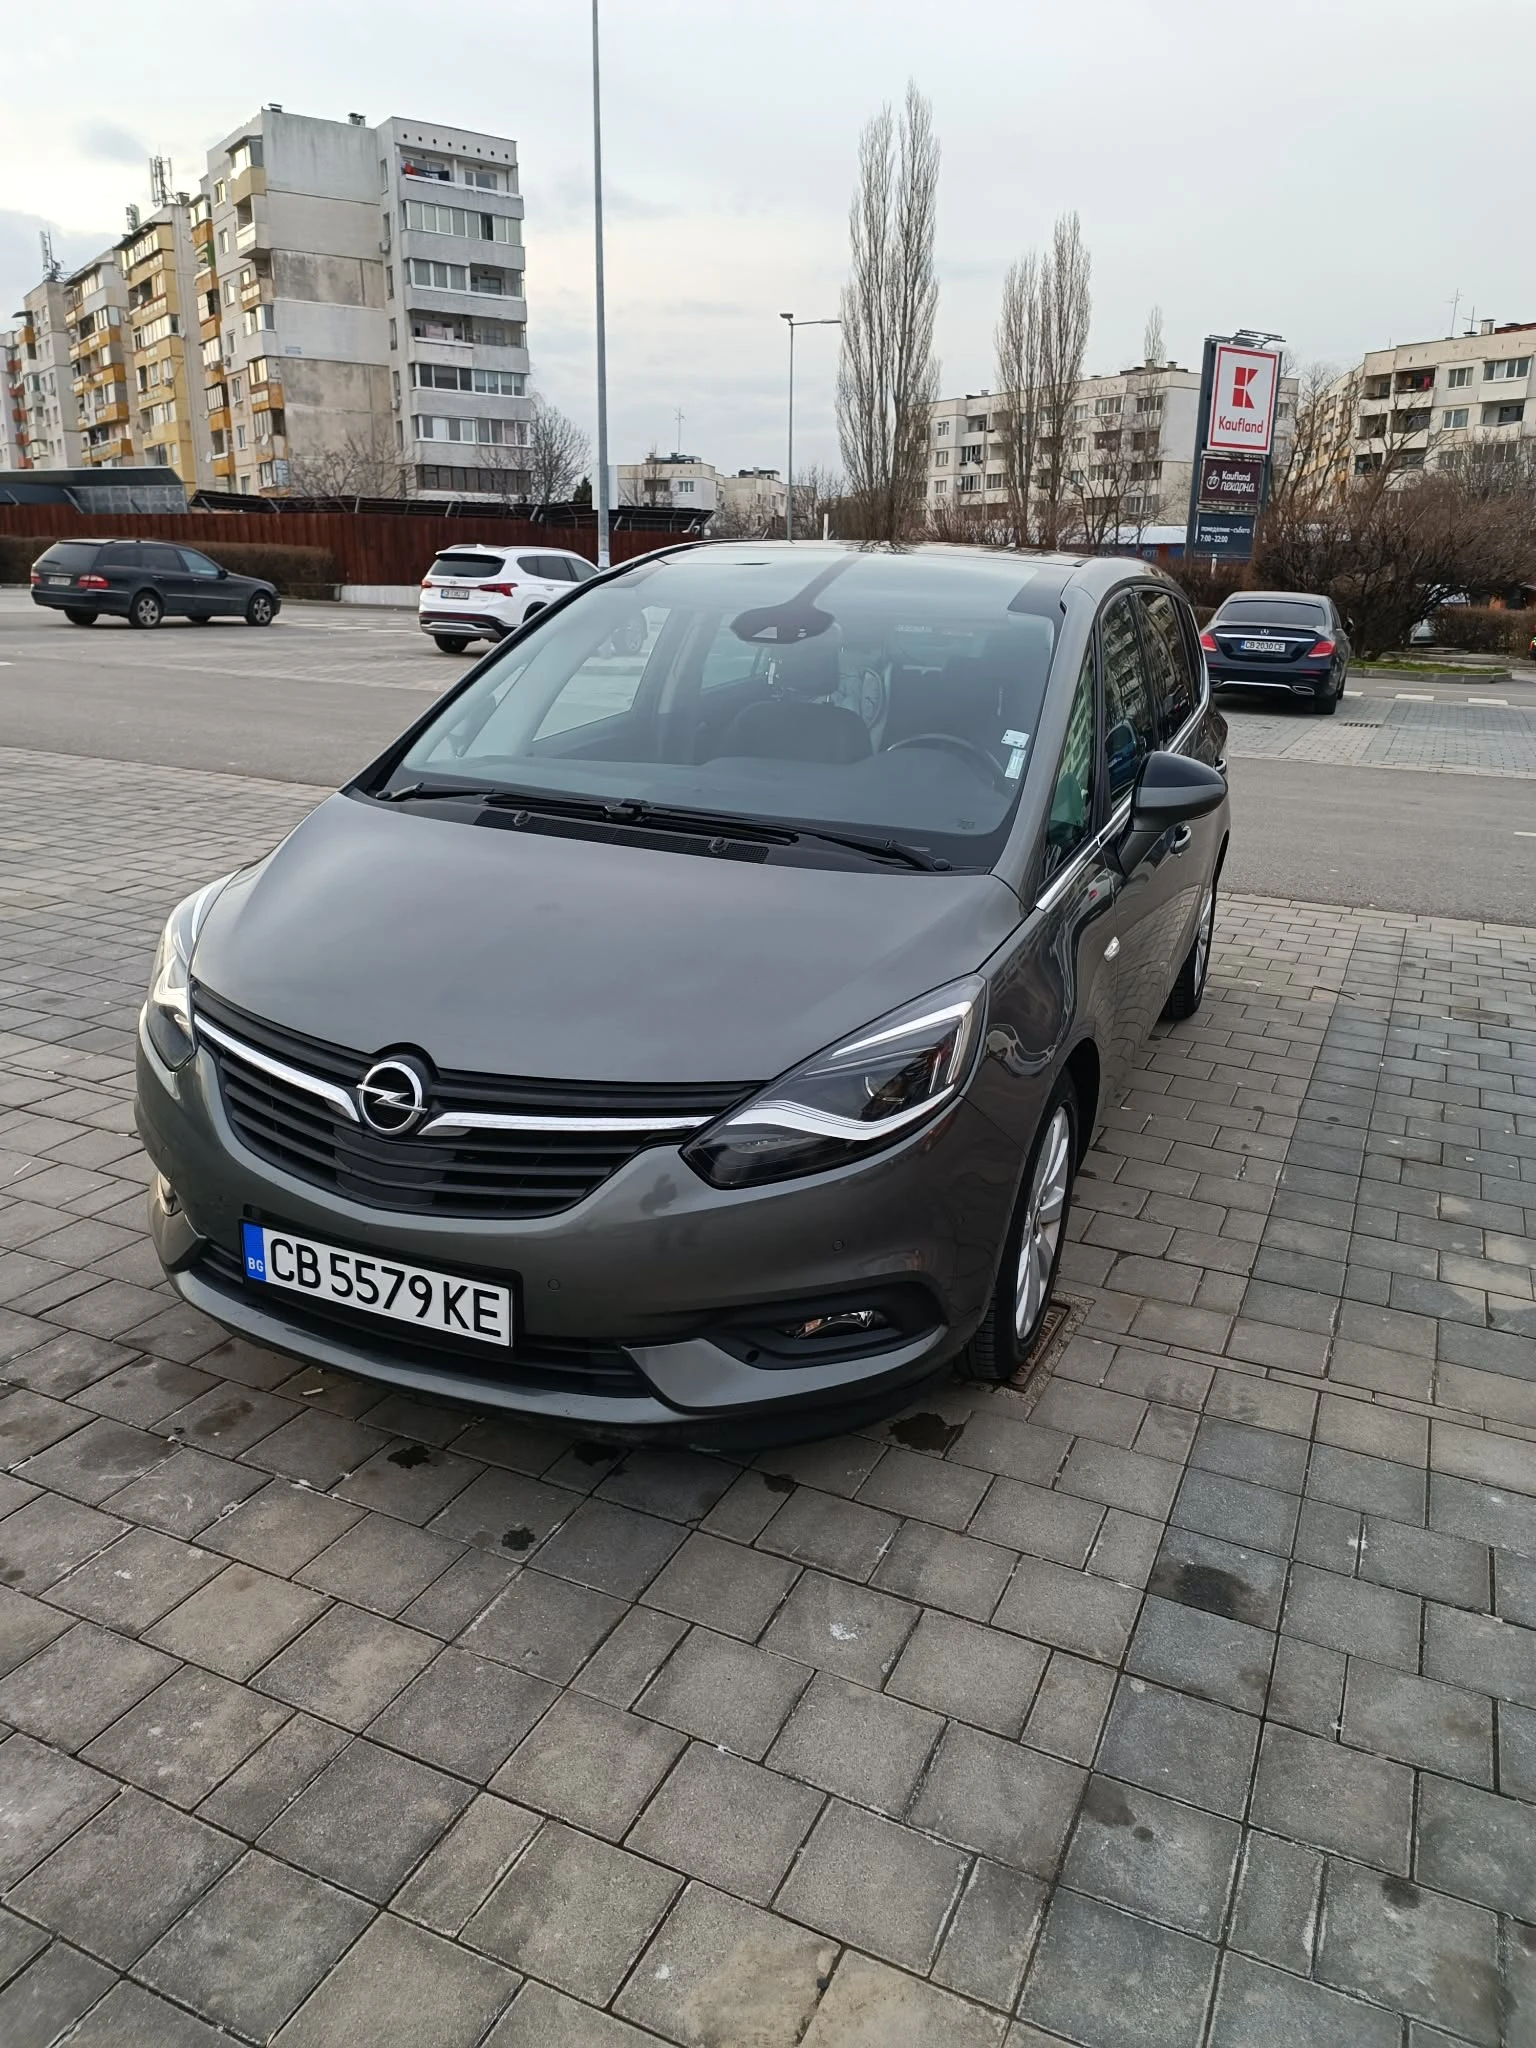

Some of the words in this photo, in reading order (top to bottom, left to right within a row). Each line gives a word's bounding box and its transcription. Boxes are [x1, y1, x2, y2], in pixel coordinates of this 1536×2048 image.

[1232, 366, 1259, 409] K
[1218, 415, 1264, 434] Kaufland
[1221, 470, 1251, 482] Kaufland
[1220, 481, 1255, 494] пекарна
[247, 1256, 264, 1273] BG
